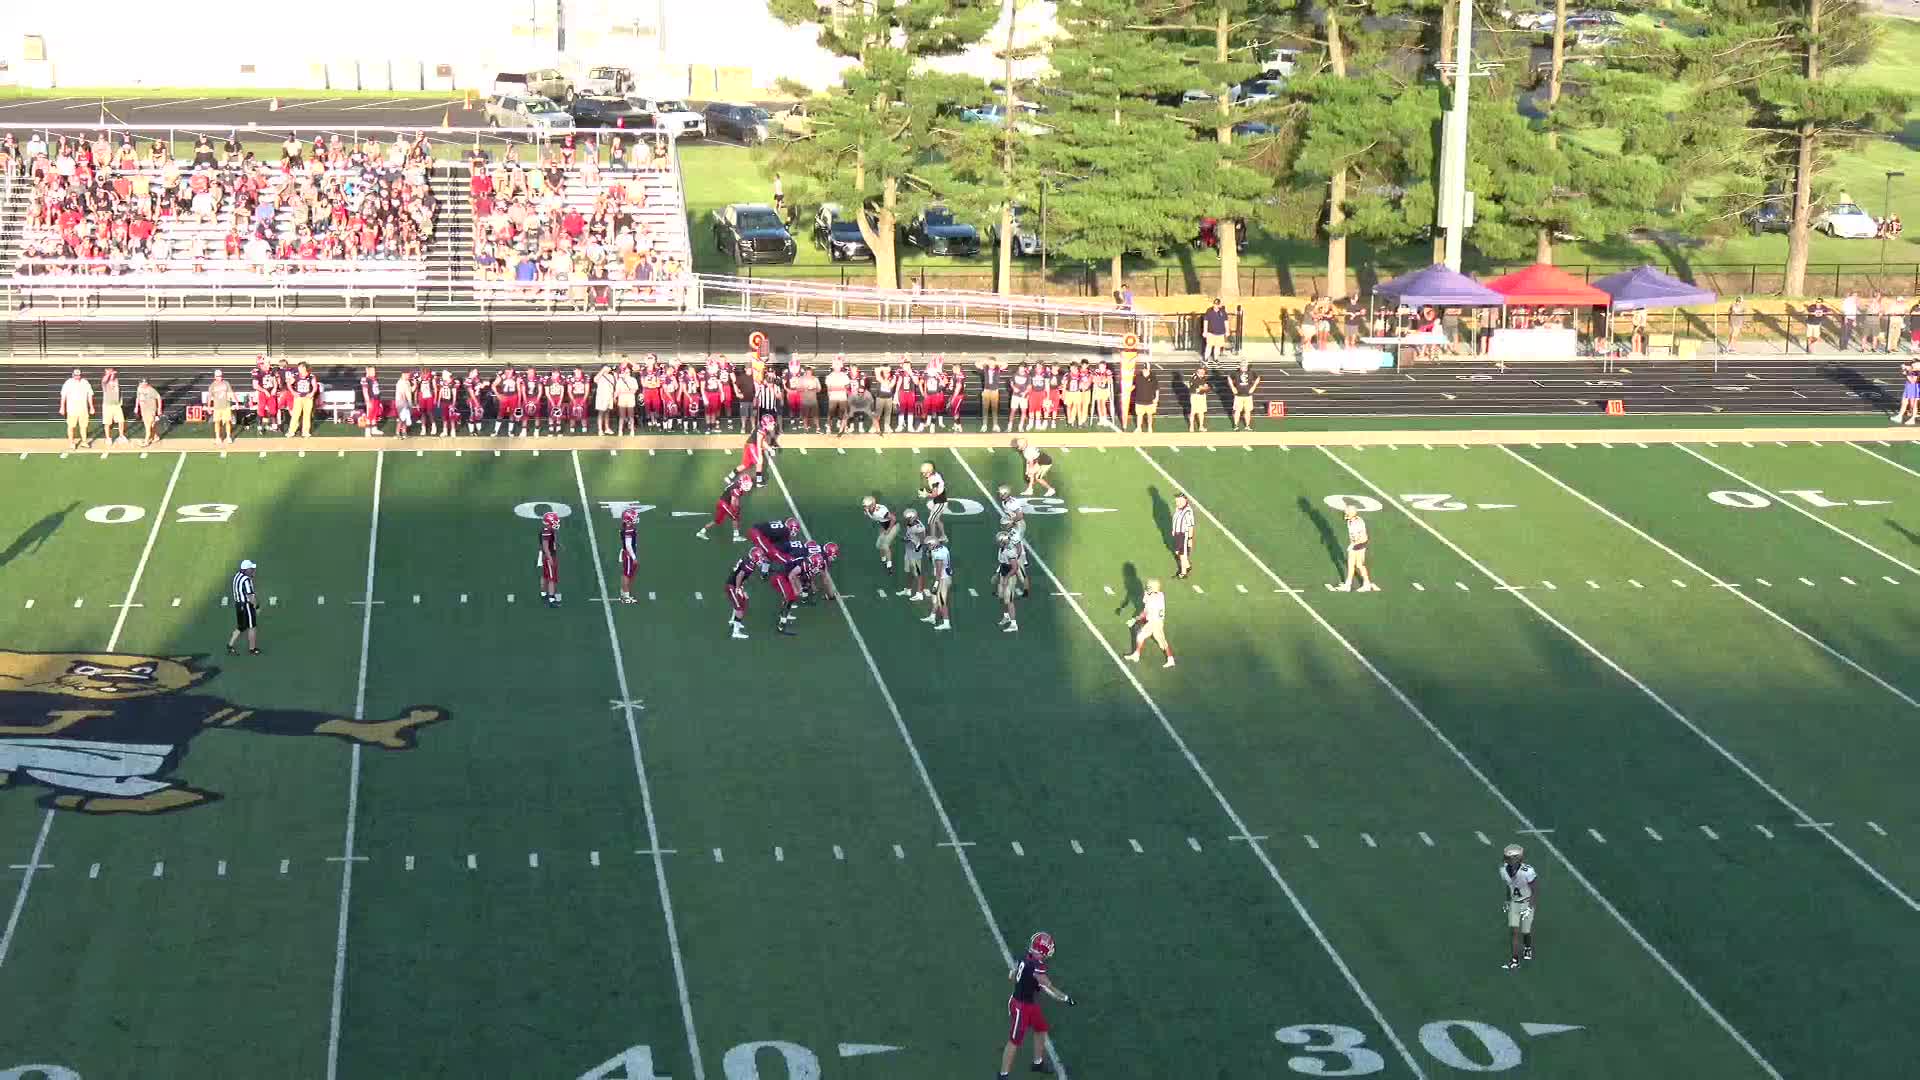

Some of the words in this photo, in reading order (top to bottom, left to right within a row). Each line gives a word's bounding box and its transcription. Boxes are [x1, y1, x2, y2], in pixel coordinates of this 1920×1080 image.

[187, 407, 201, 419] 50
[1270, 403, 1282, 415] 20
[1610, 401, 1621, 413] 10
[1323, 494, 1468, 511] 20
[1707, 490, 1849, 508] 10
[84, 503, 239, 523] 50
[1275, 1019, 1522, 1077] 30
